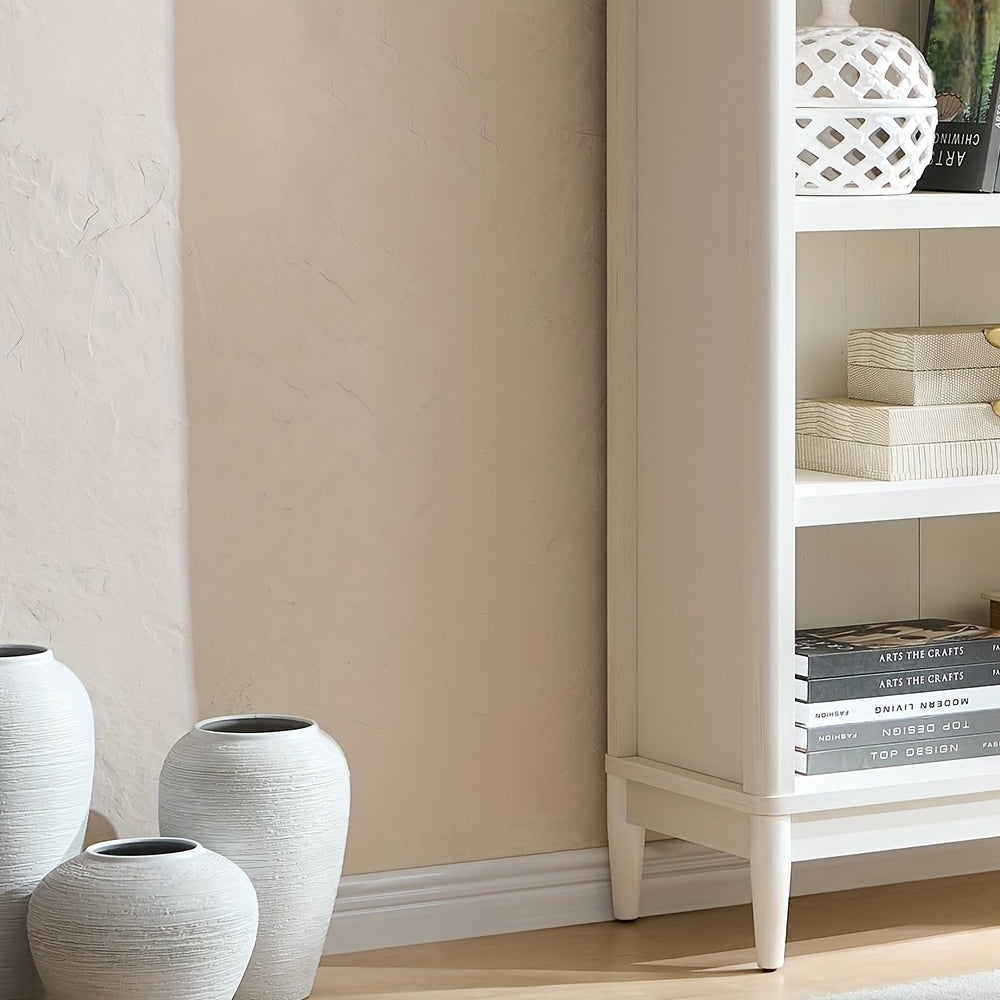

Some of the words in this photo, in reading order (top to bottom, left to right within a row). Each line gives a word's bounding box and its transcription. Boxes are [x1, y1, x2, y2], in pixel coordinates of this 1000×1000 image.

[879, 648, 903, 663] ARTS
[906, 648, 925, 661] THE
[928, 645, 965, 658] CRAFTS
[879, 675, 903, 689] ARTS
[906, 673, 925, 687] THE
[928, 671, 965, 684] CRAFTS
[874, 703, 914, 715] LIVING
[920, 697, 970, 711] MODERN
[815, 709, 850, 720] FASHION
[882, 723, 936, 737] DESIGN
[943, 720, 970, 731] TOP
[818, 732, 858, 743] FASHION
[870, 749, 898, 761] TOP
[905, 743, 959, 757] DESIGN
